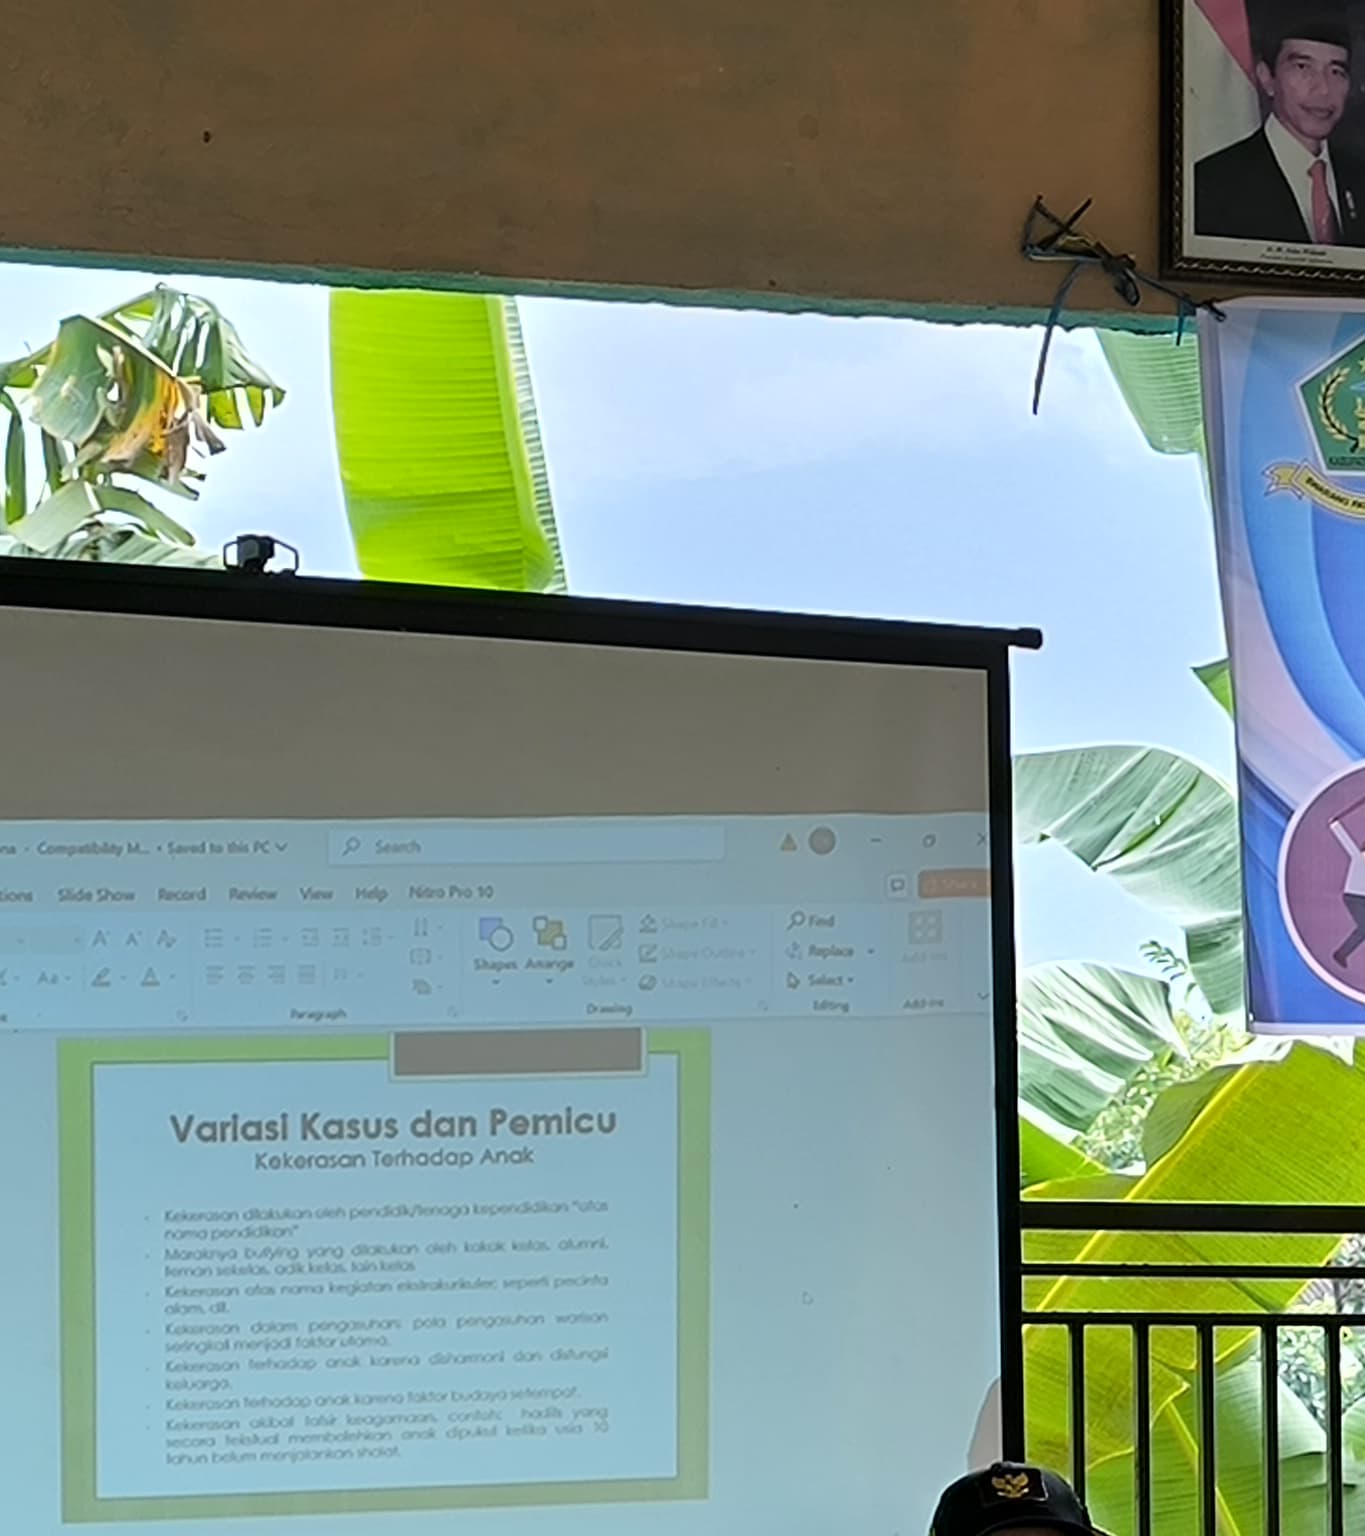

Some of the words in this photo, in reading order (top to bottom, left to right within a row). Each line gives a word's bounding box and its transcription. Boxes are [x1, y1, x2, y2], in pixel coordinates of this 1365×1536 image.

[37, 841, 123, 857] Compatibility
[167, 841, 206, 854] Saved
[209, 842, 223, 854] to
[227, 840, 249, 854] this
[253, 841, 269, 854] PC
[375, 839, 421, 854] Search
[57, 888, 93, 902] Slide
[96, 888, 135, 902] Show
[158, 887, 206, 901] Record
[229, 887, 277, 901] Review
[299, 887, 334, 900] View
[355, 885, 389, 903] Help
[409, 884, 445, 899] Nitro
[448, 884, 473, 899] Pro
[477, 884, 494, 899] 10
[808, 914, 834, 928] Find
[808, 945, 853, 960] Replace
[474, 958, 517, 973] Shapes
[808, 974, 843, 987] Select
[812, 1000, 850, 1013] Editing
[169, 1112, 289, 1144] Variasi
[300, 1111, 400, 1142] Kasus
[410, 1108, 477, 1139] dan
[490, 1106, 617, 1136] Pemicu
[255, 1150, 366, 1171] Kekerasan
[372, 1149, 474, 1171] Terhadap
[480, 1146, 535, 1166] Anak
[164, 1209, 239, 1222] Kekerasan
